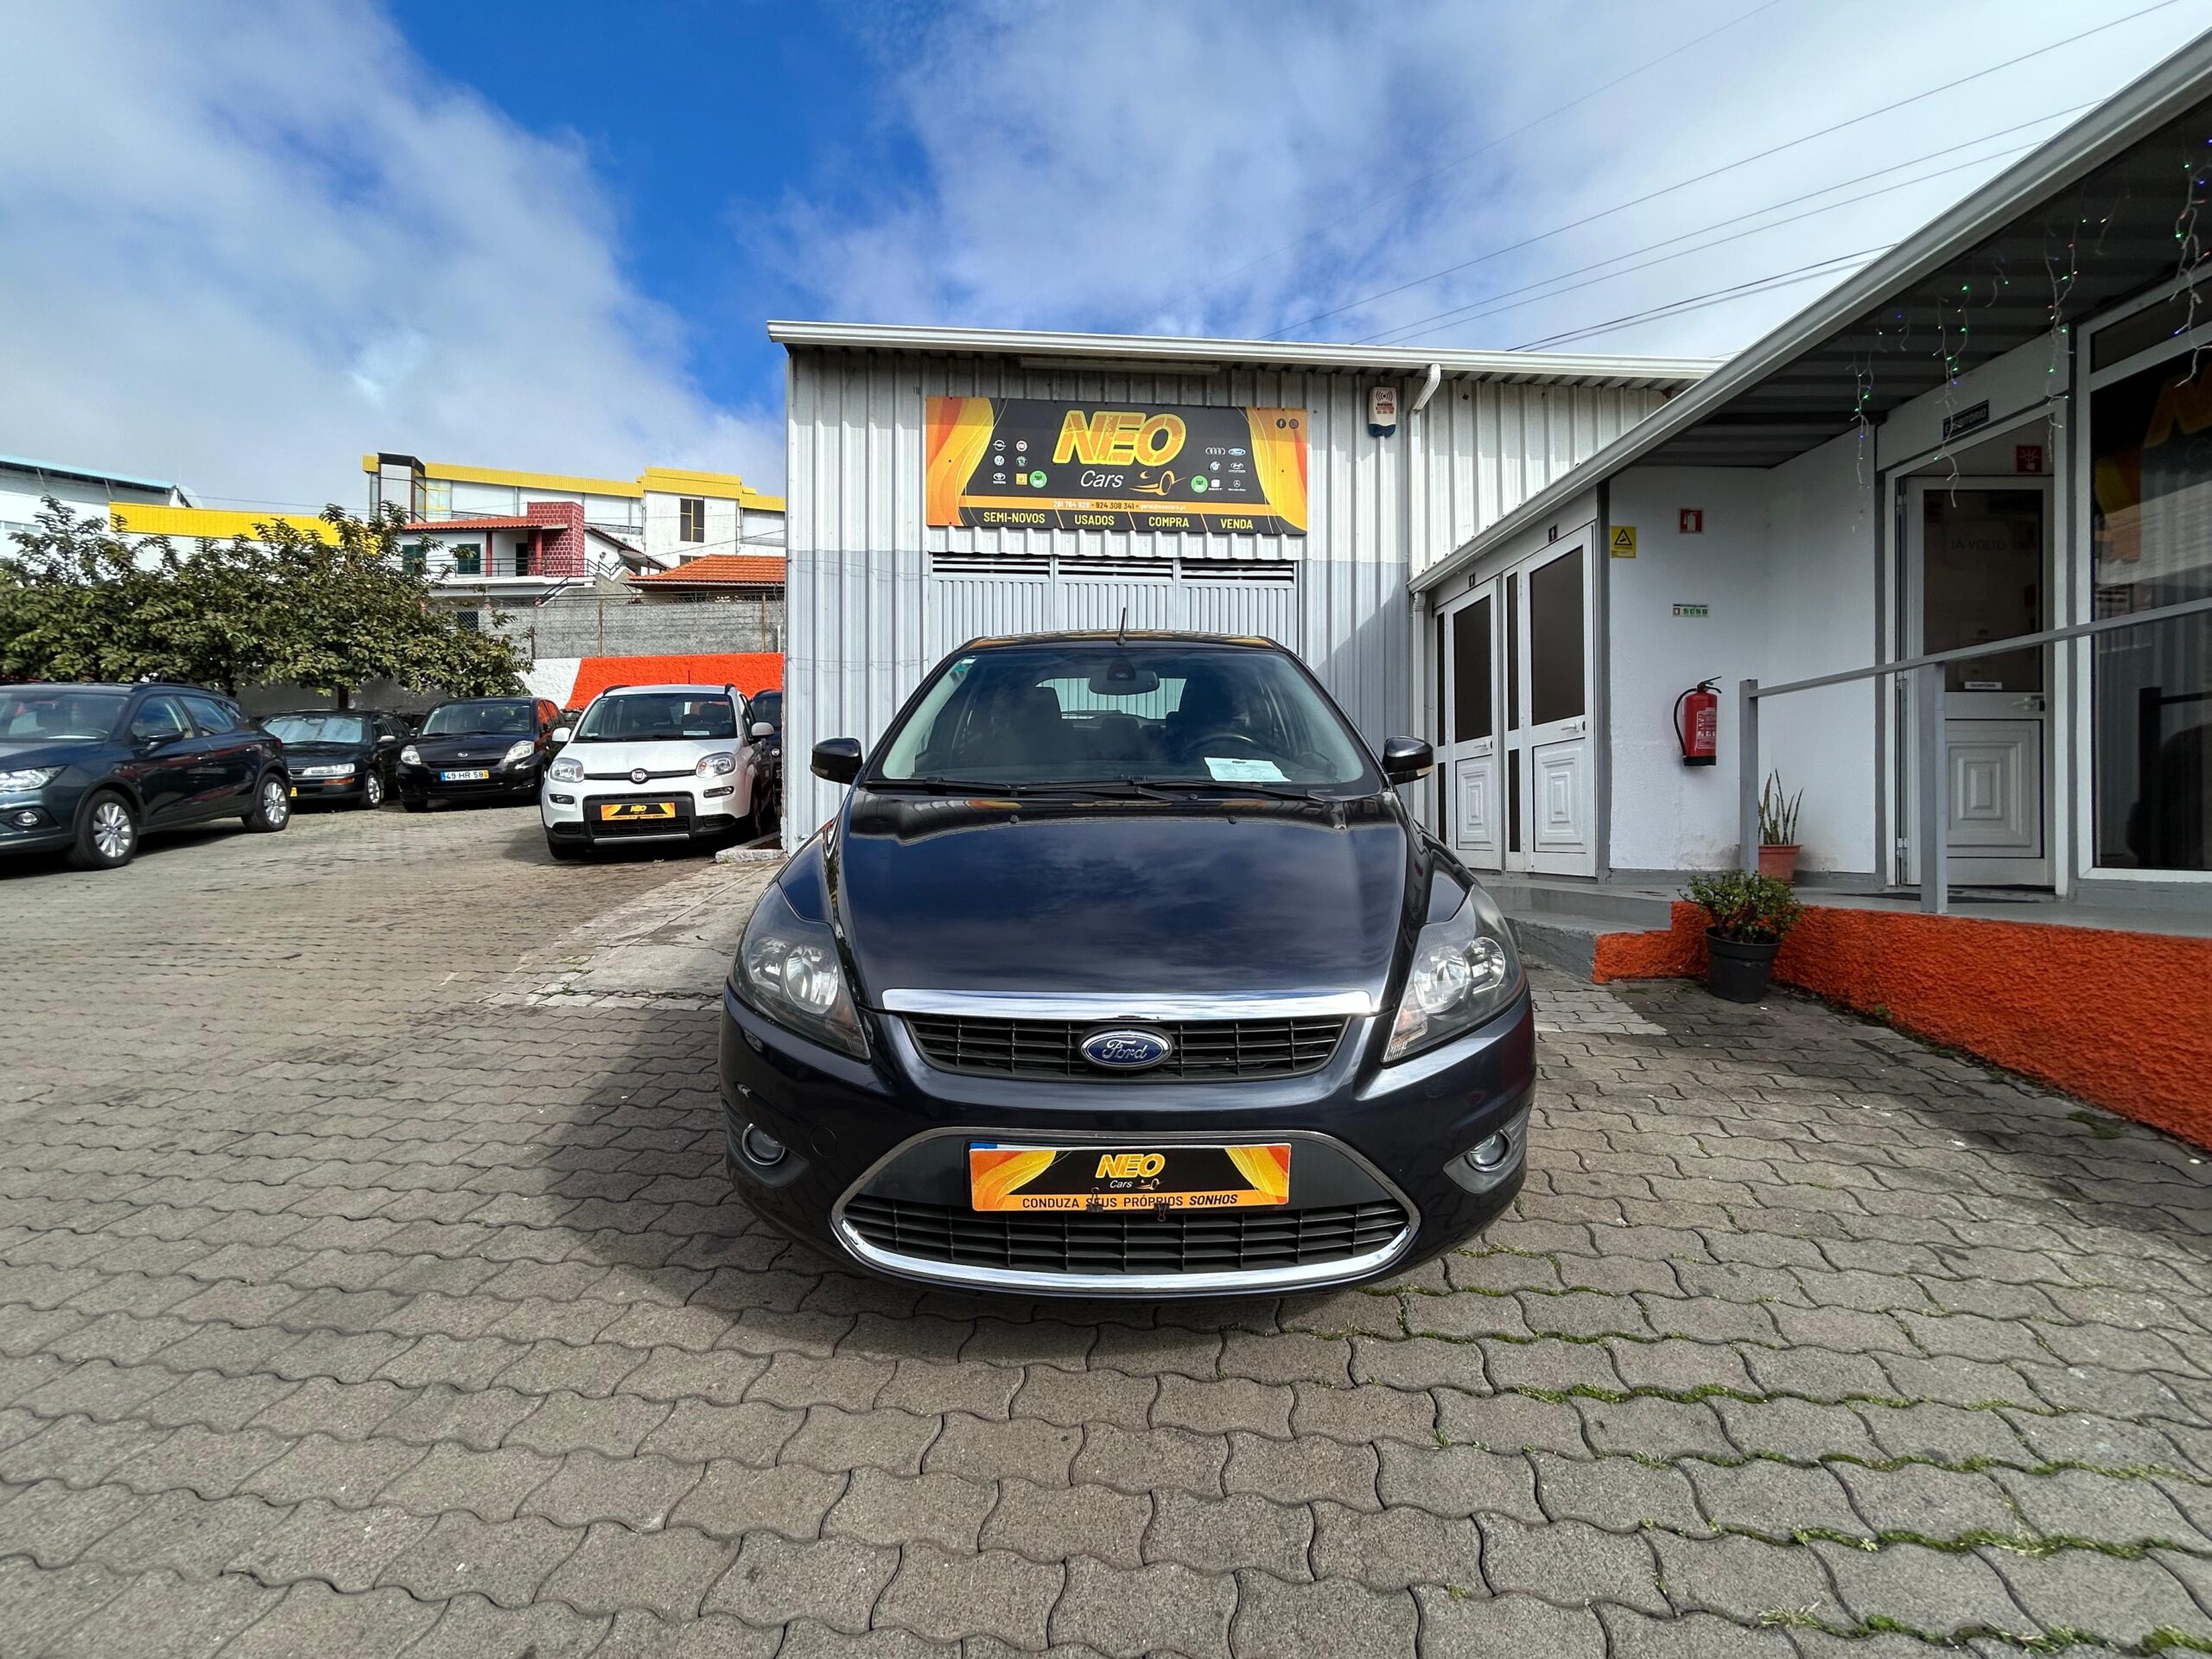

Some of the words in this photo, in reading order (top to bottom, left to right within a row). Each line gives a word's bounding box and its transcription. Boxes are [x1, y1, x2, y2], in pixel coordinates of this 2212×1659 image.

[1052, 410, 1186, 465] NEO
[1079, 470, 1123, 488] Cars
[983, 511, 1046, 524] SEMI-NOVOS
[1074, 514, 1115, 525] USADOS
[1148, 516, 1190, 528] COMPRA
[1220, 518, 1254, 530] VENDA
[1103, 1039, 1147, 1059] Ford
[1096, 1154, 1166, 1179] NEO
[1109, 1179, 1133, 1189] Cars
[1022, 1198, 1080, 1209] CONDUZA
[1188, 1193, 1238, 1206] SONHOS
